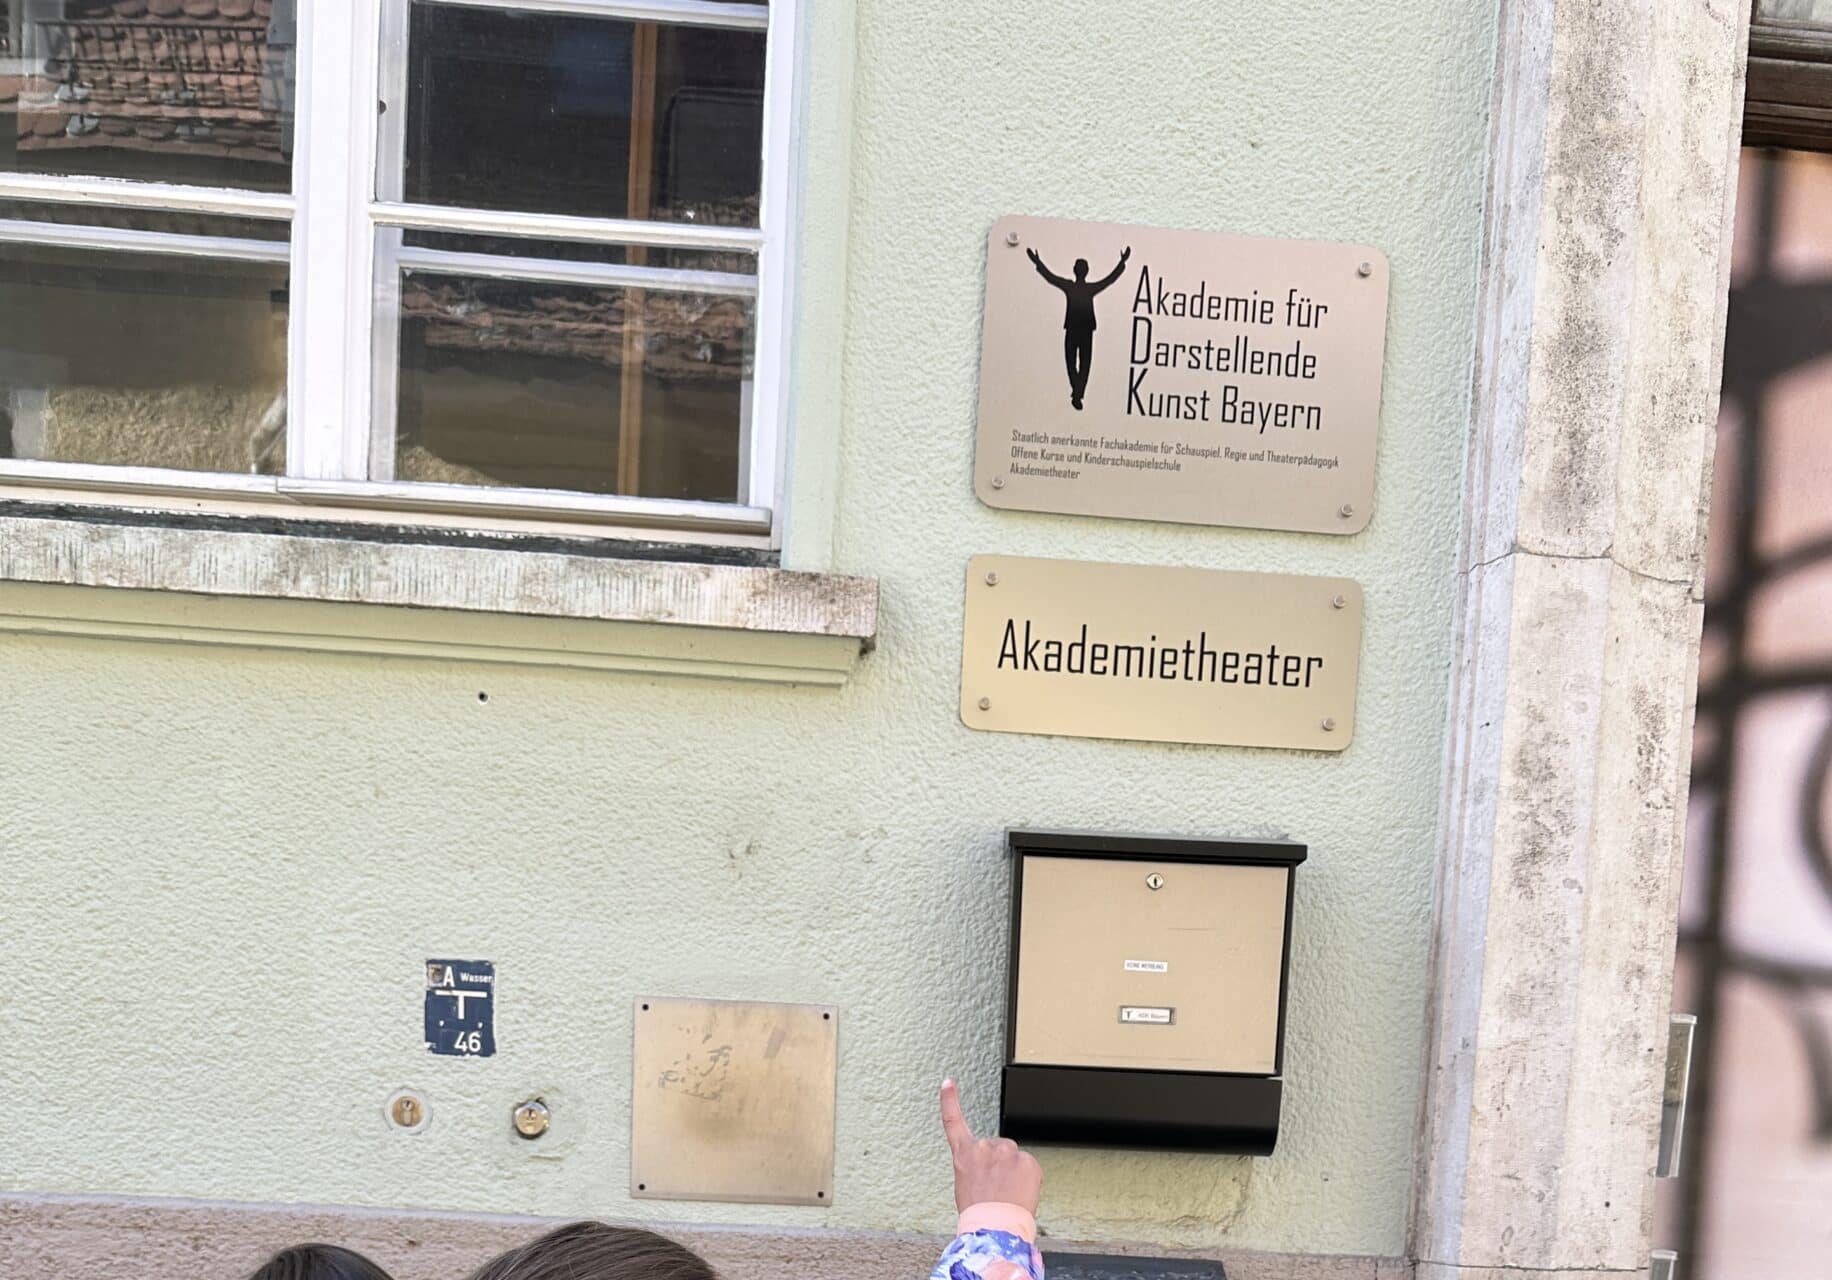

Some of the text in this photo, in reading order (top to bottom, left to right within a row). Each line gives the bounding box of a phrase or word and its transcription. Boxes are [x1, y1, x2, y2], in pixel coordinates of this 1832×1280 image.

[1132, 265, 1328, 328] Akademie für
[1130, 316, 1317, 380] Darstellende
[1126, 367, 1322, 434] Kunst Bayern
[1010, 462, 1081, 479] Akademietheater
[1011, 446, 1181, 471] Offene Kurse und Kinderschauspielschule
[1012, 429, 1049, 444] Staatlich
[1051, 435, 1098, 449] anerkannte
[1100, 437, 1158, 453] Fachakademie
[1160, 441, 1174, 455] für
[1224, 447, 1247, 462] Regie
[1250, 450, 1264, 462] und
[1267, 450, 1339, 469] Theaterpädagogik
[997, 618, 1323, 688] Akademietheater
[454, 1031, 481, 1053] 46
